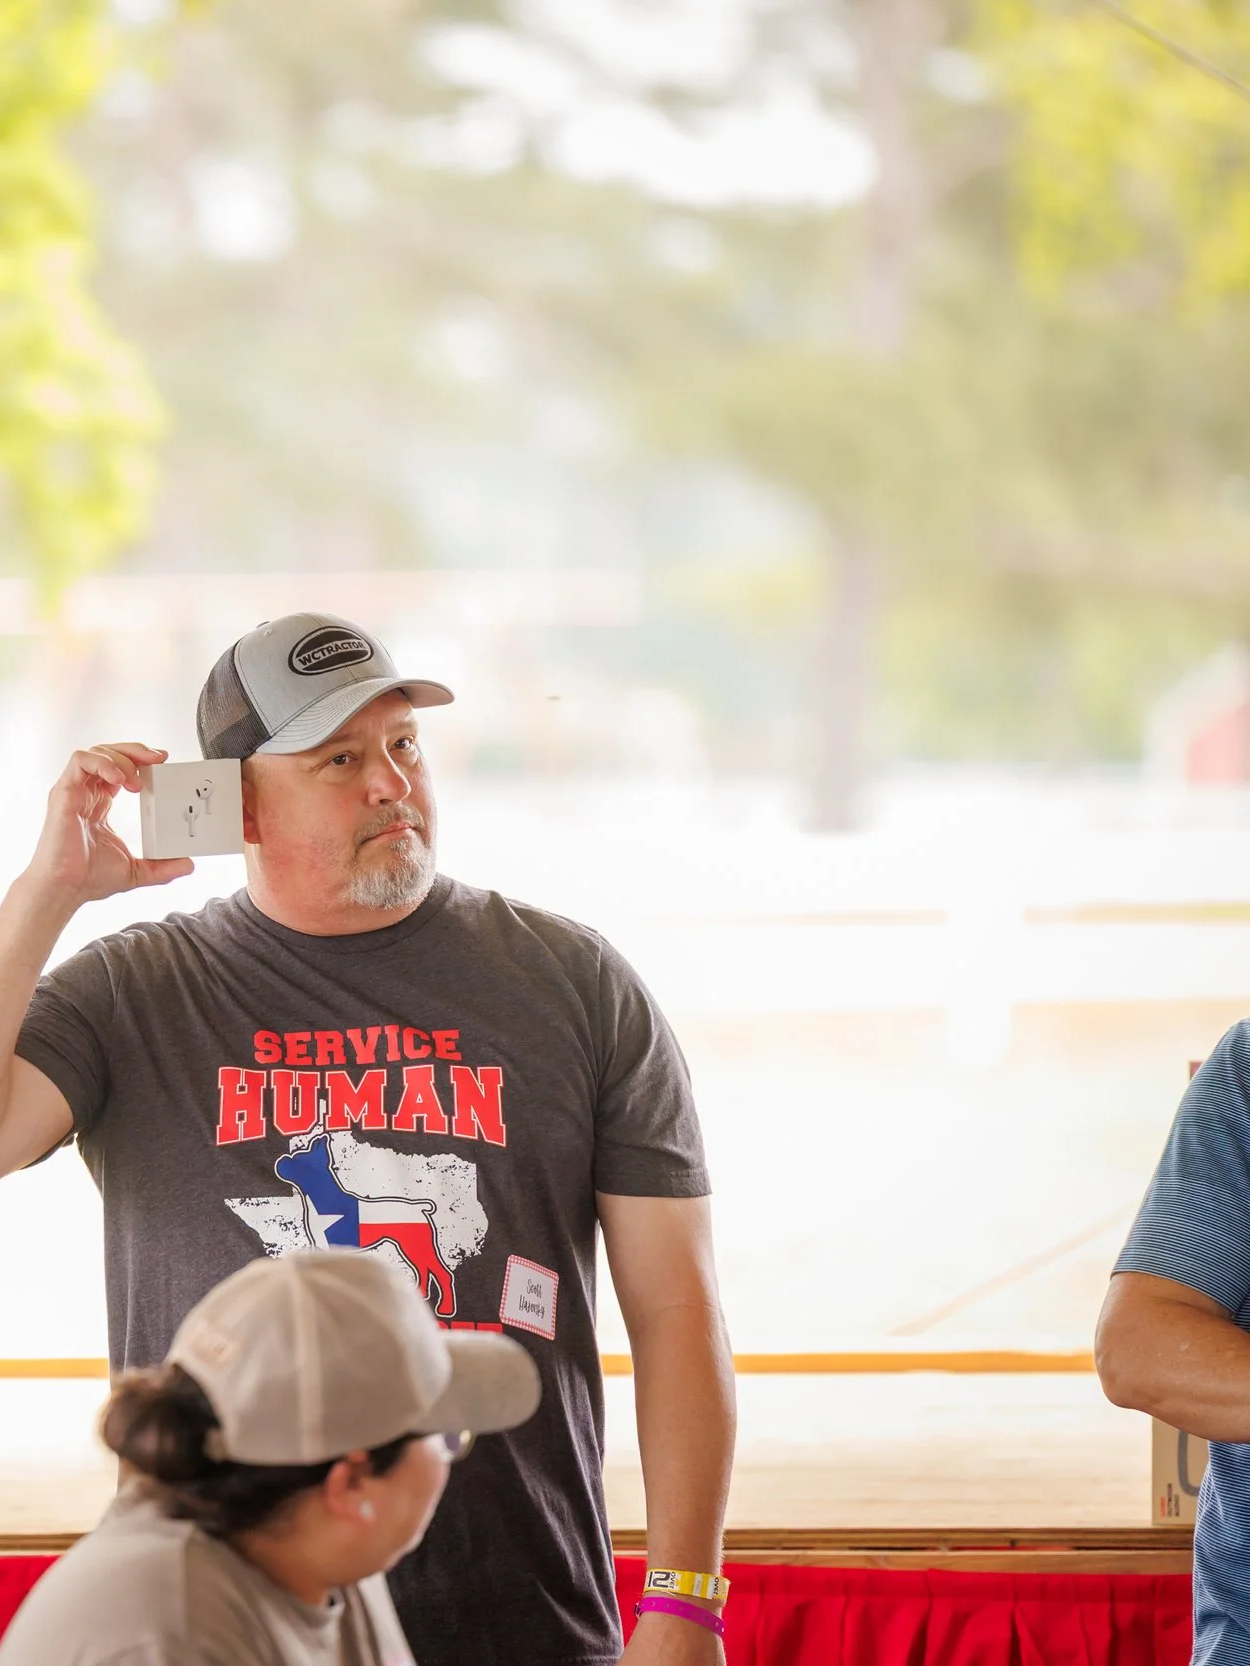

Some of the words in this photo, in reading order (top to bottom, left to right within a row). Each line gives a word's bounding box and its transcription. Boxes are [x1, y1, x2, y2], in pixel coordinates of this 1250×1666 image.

[297, 641, 366, 667] WCTRACTOR
[253, 1023, 463, 1067] SERVICE
[215, 1063, 507, 1148] HUMAN
[526, 1279, 543, 1299] Scott
